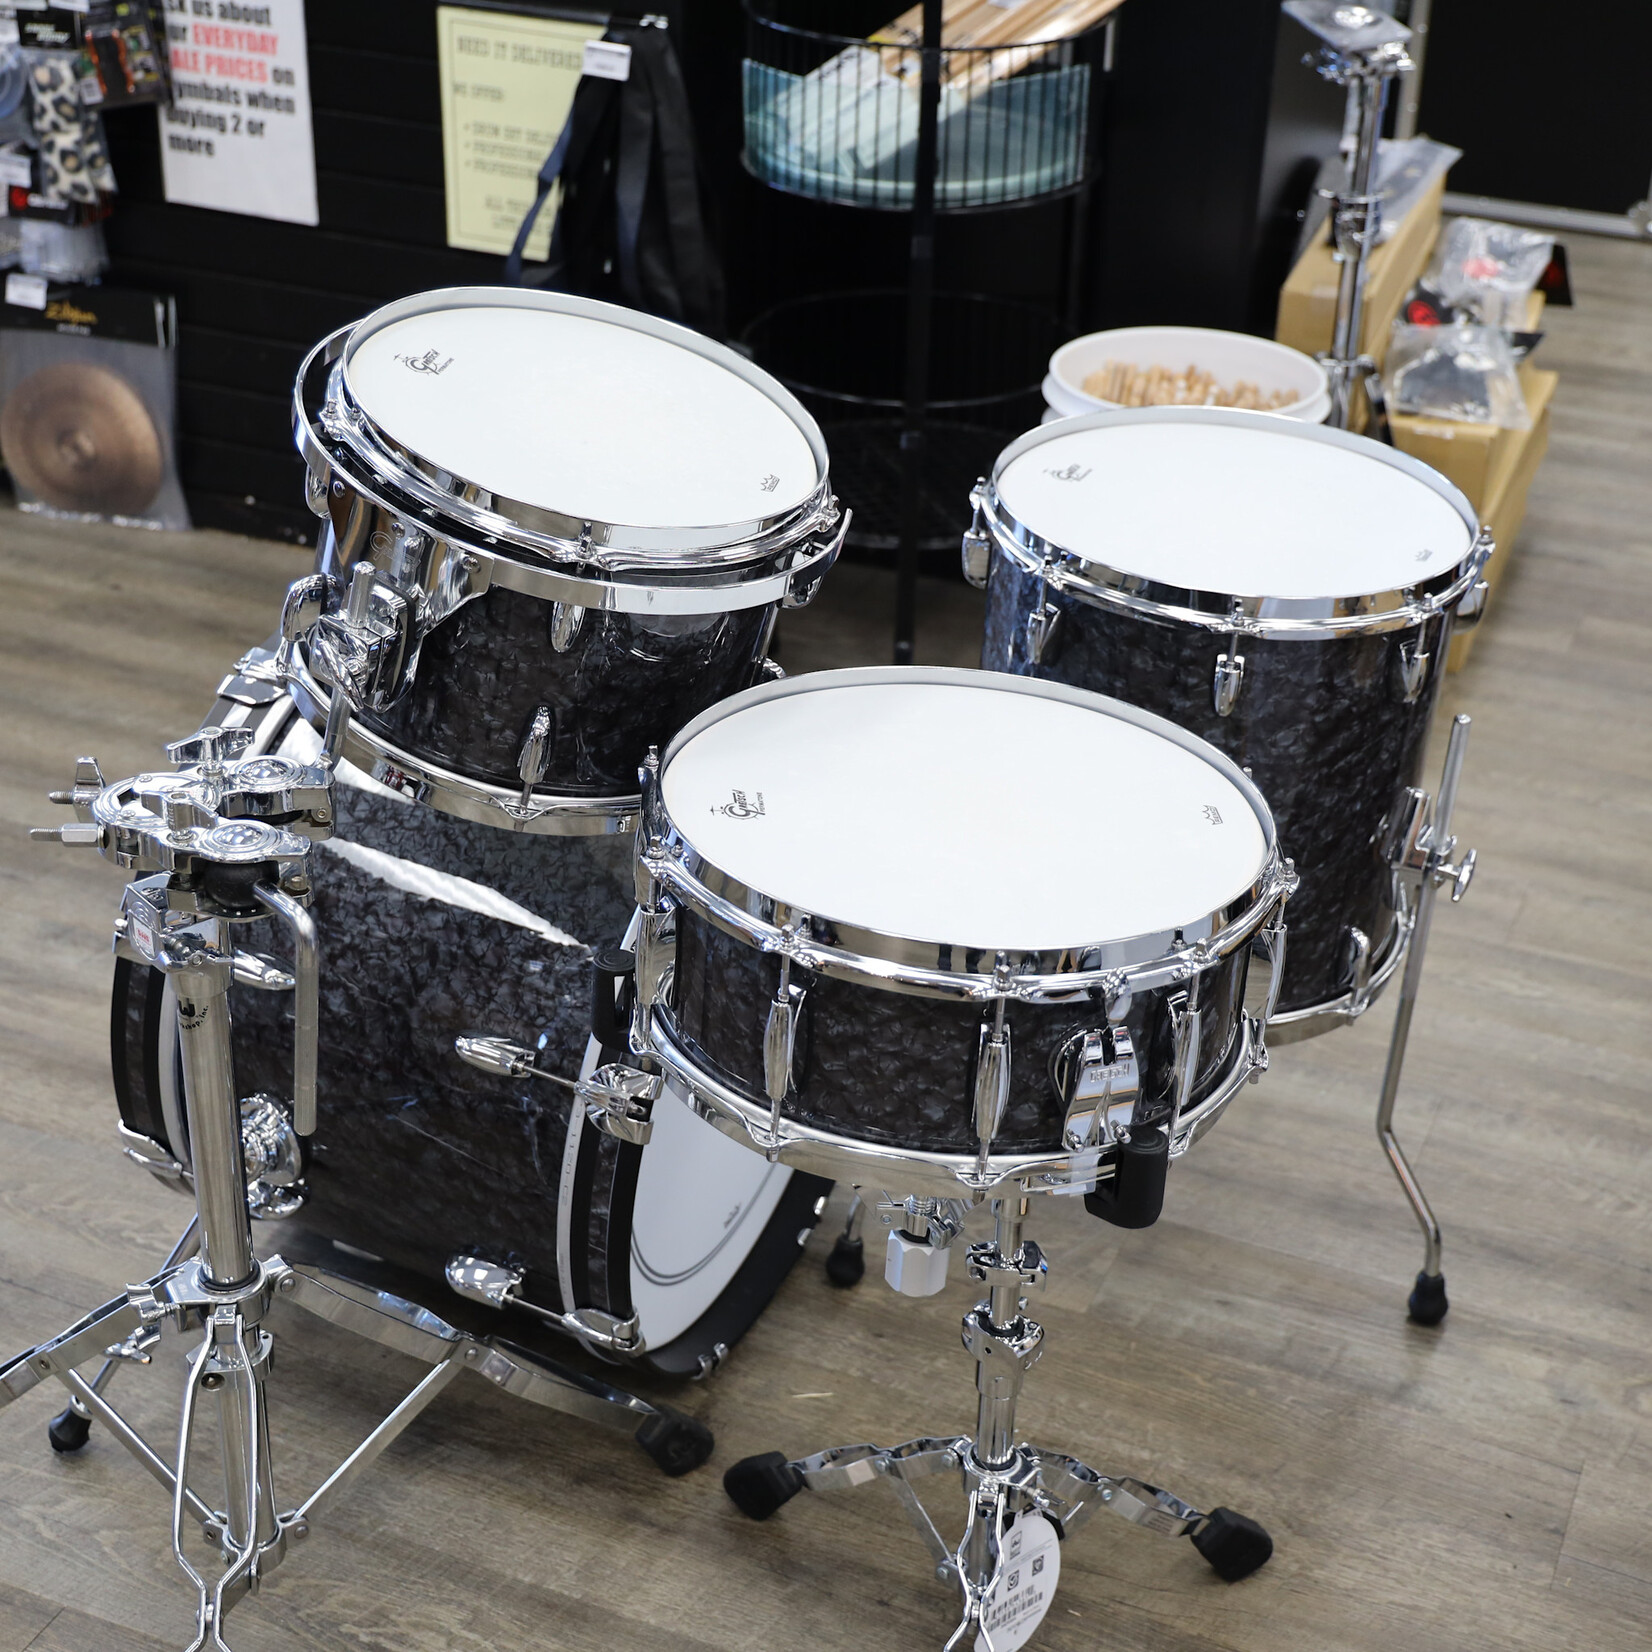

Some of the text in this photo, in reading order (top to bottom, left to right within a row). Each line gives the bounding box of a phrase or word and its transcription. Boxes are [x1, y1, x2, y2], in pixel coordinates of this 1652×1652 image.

[192, 0, 214, 17] us
[219, 2, 271, 25] about
[167, 23, 279, 55] ur EVERYDAY
[171, 46, 295, 85] ALE PRICES on
[174, 80, 296, 114] ymbals when
[166, 106, 265, 136] buying 2 or
[168, 135, 215, 156] more
